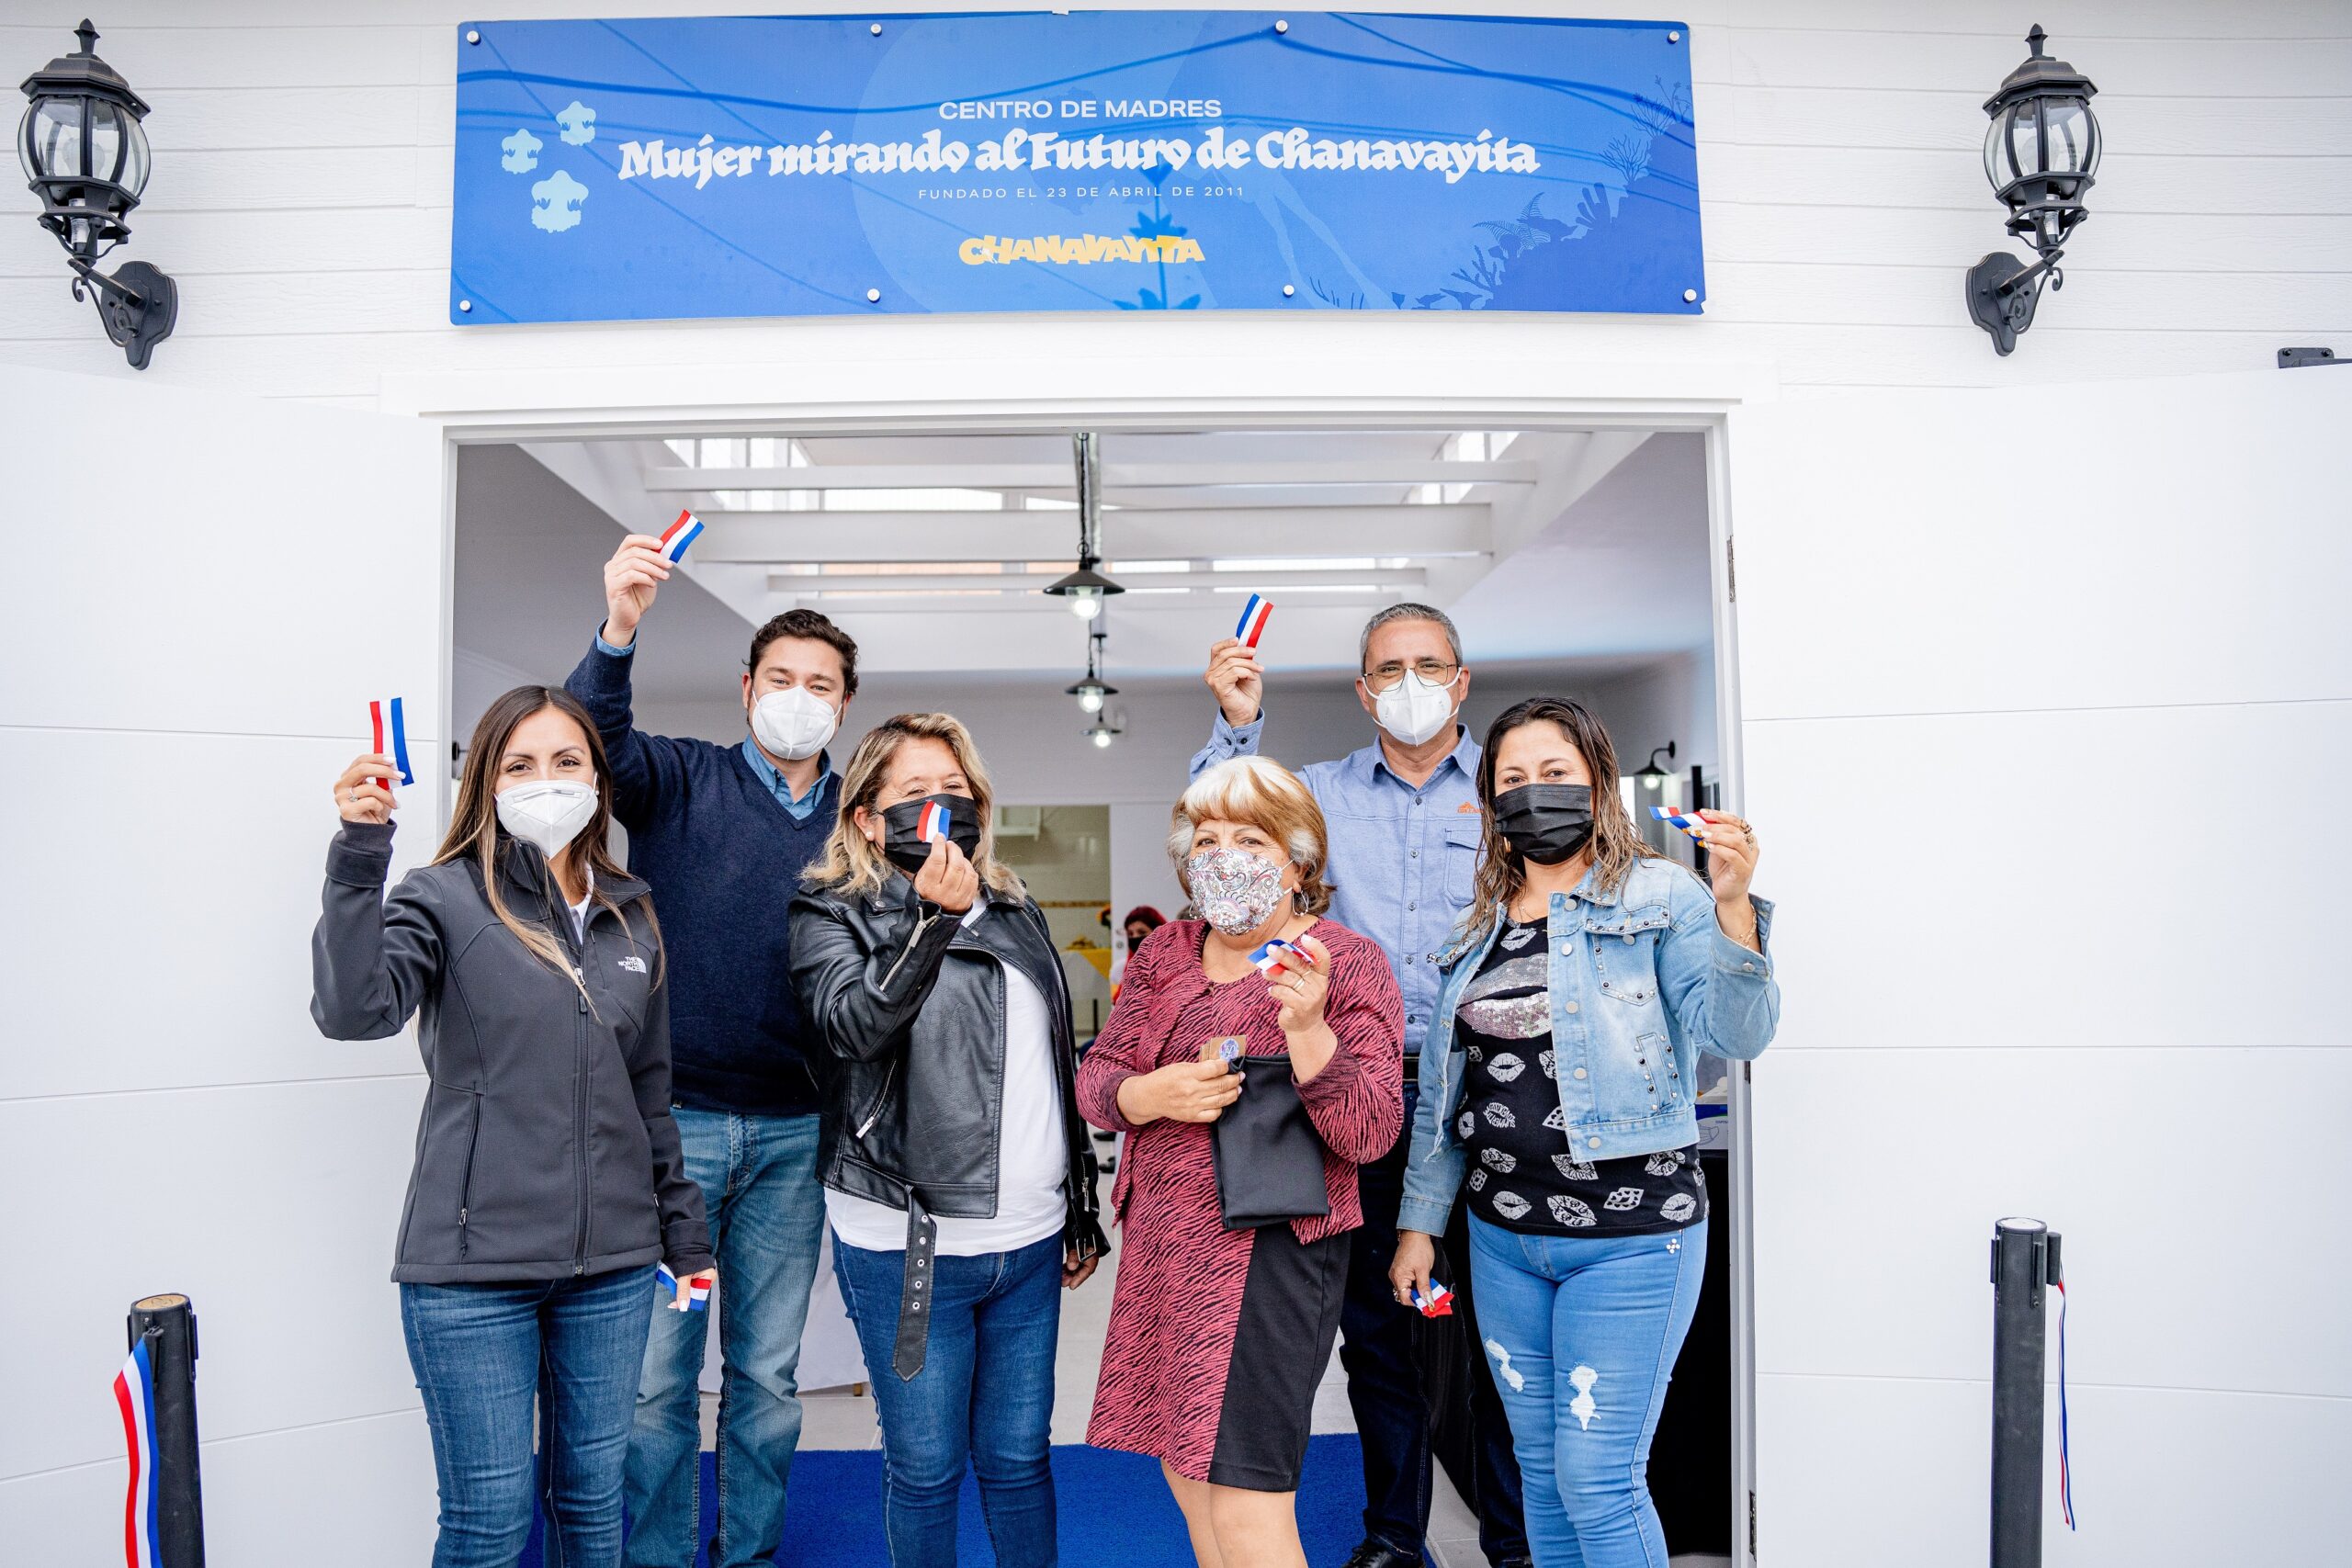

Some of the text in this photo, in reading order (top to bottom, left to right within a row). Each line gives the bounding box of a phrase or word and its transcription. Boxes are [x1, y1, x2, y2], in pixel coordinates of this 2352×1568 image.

[939, 99, 1222, 119] CENTRO DE MADRES
[618, 134, 763, 190] Mujer
[975, 128, 1028, 172] al
[1027, 132, 1192, 172] Futuro
[1195, 126, 1251, 170] de
[919, 186, 1243, 199] FUNDADO EL 23 DE ABRIL DE 2011
[958, 233, 1205, 265] CHANAVAYITA
